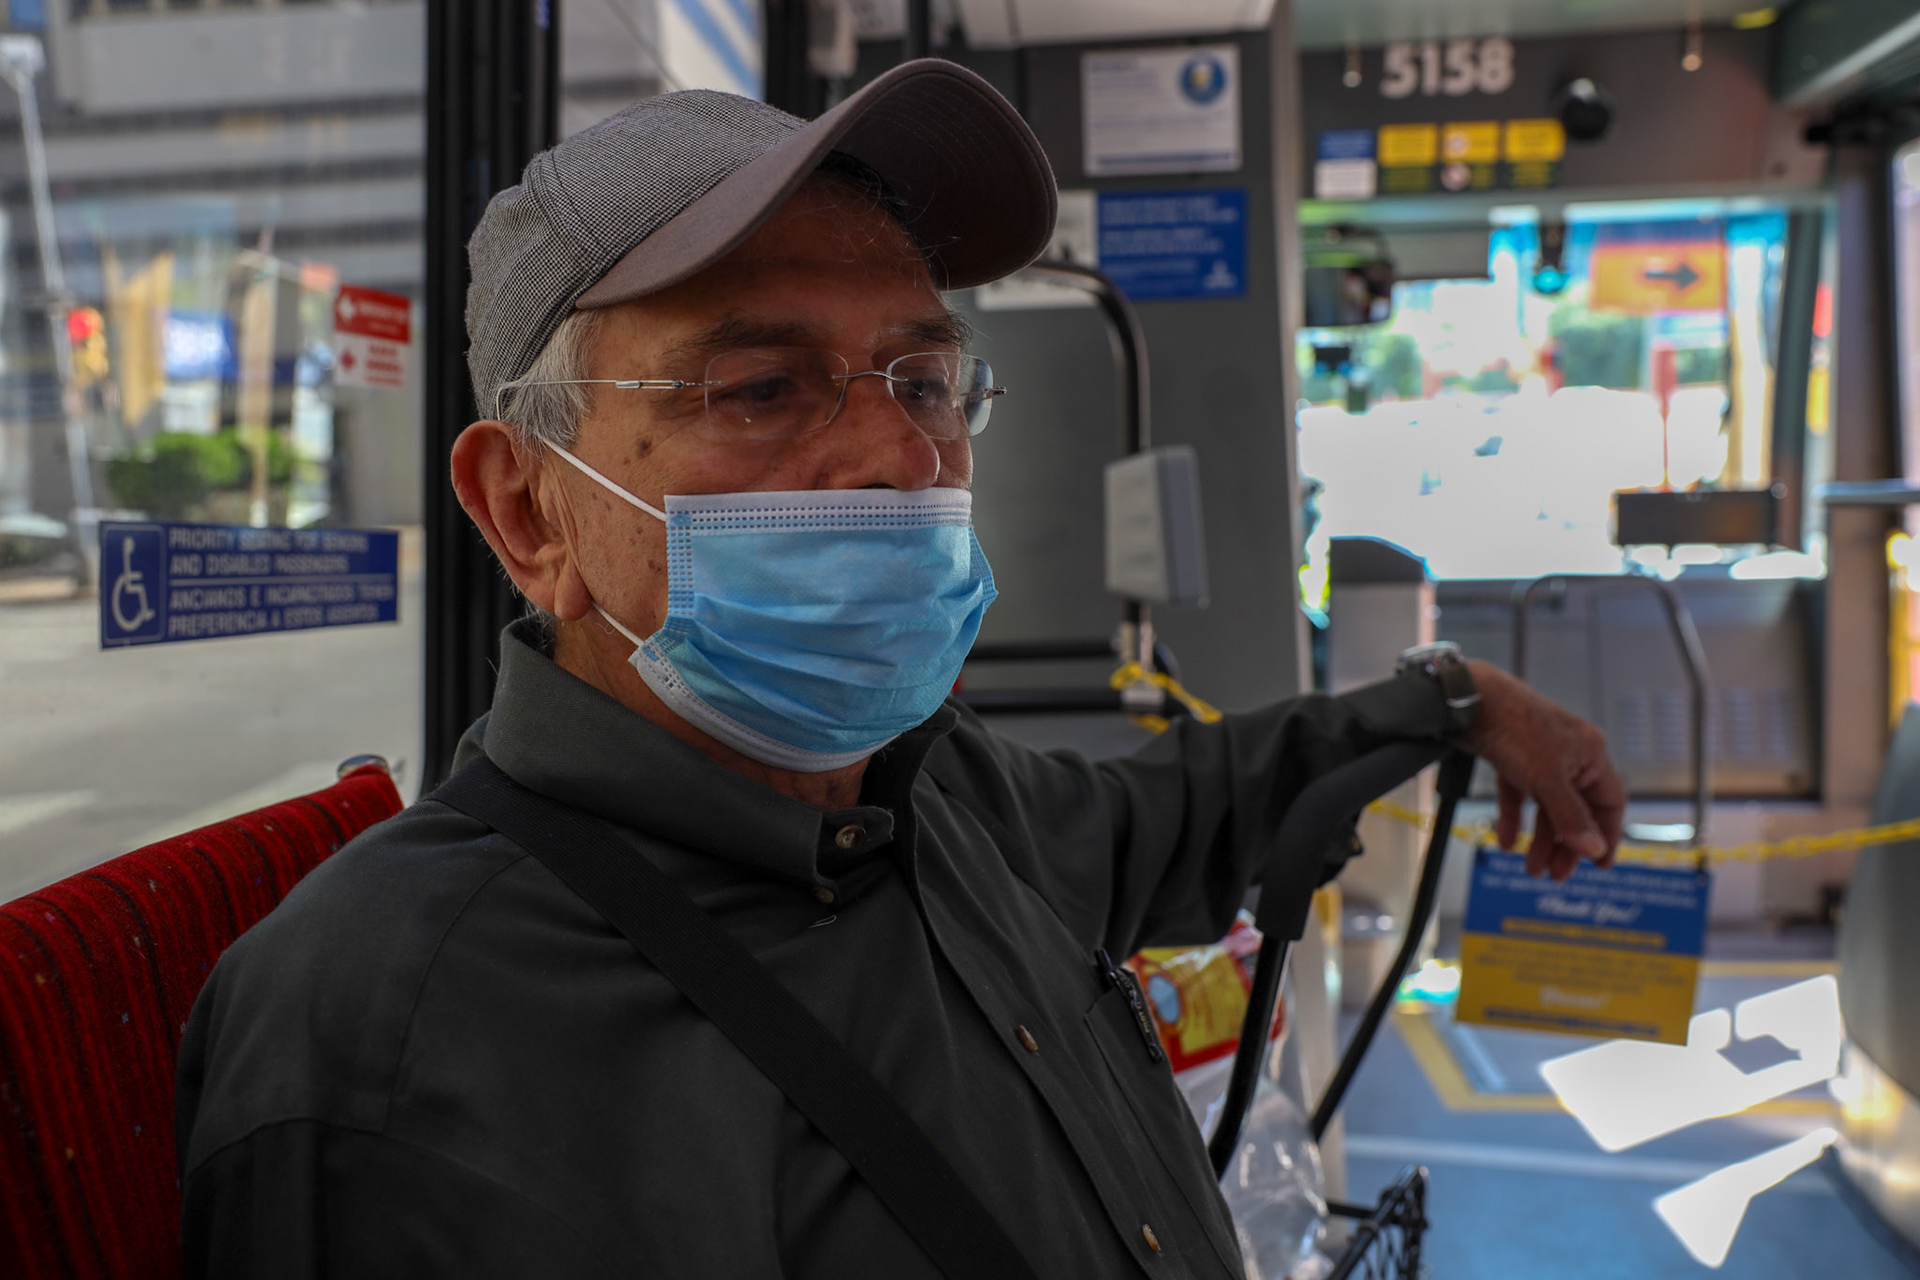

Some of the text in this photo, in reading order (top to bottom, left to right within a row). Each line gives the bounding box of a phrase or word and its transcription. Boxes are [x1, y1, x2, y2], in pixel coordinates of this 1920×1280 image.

[1381, 39, 1515, 98] 5158
[168, 527, 234, 550] PRIORITY
[169, 554, 203, 576] AND
[205, 553, 271, 575] DISABLED
[168, 610, 267, 637] PREFERENCIA
